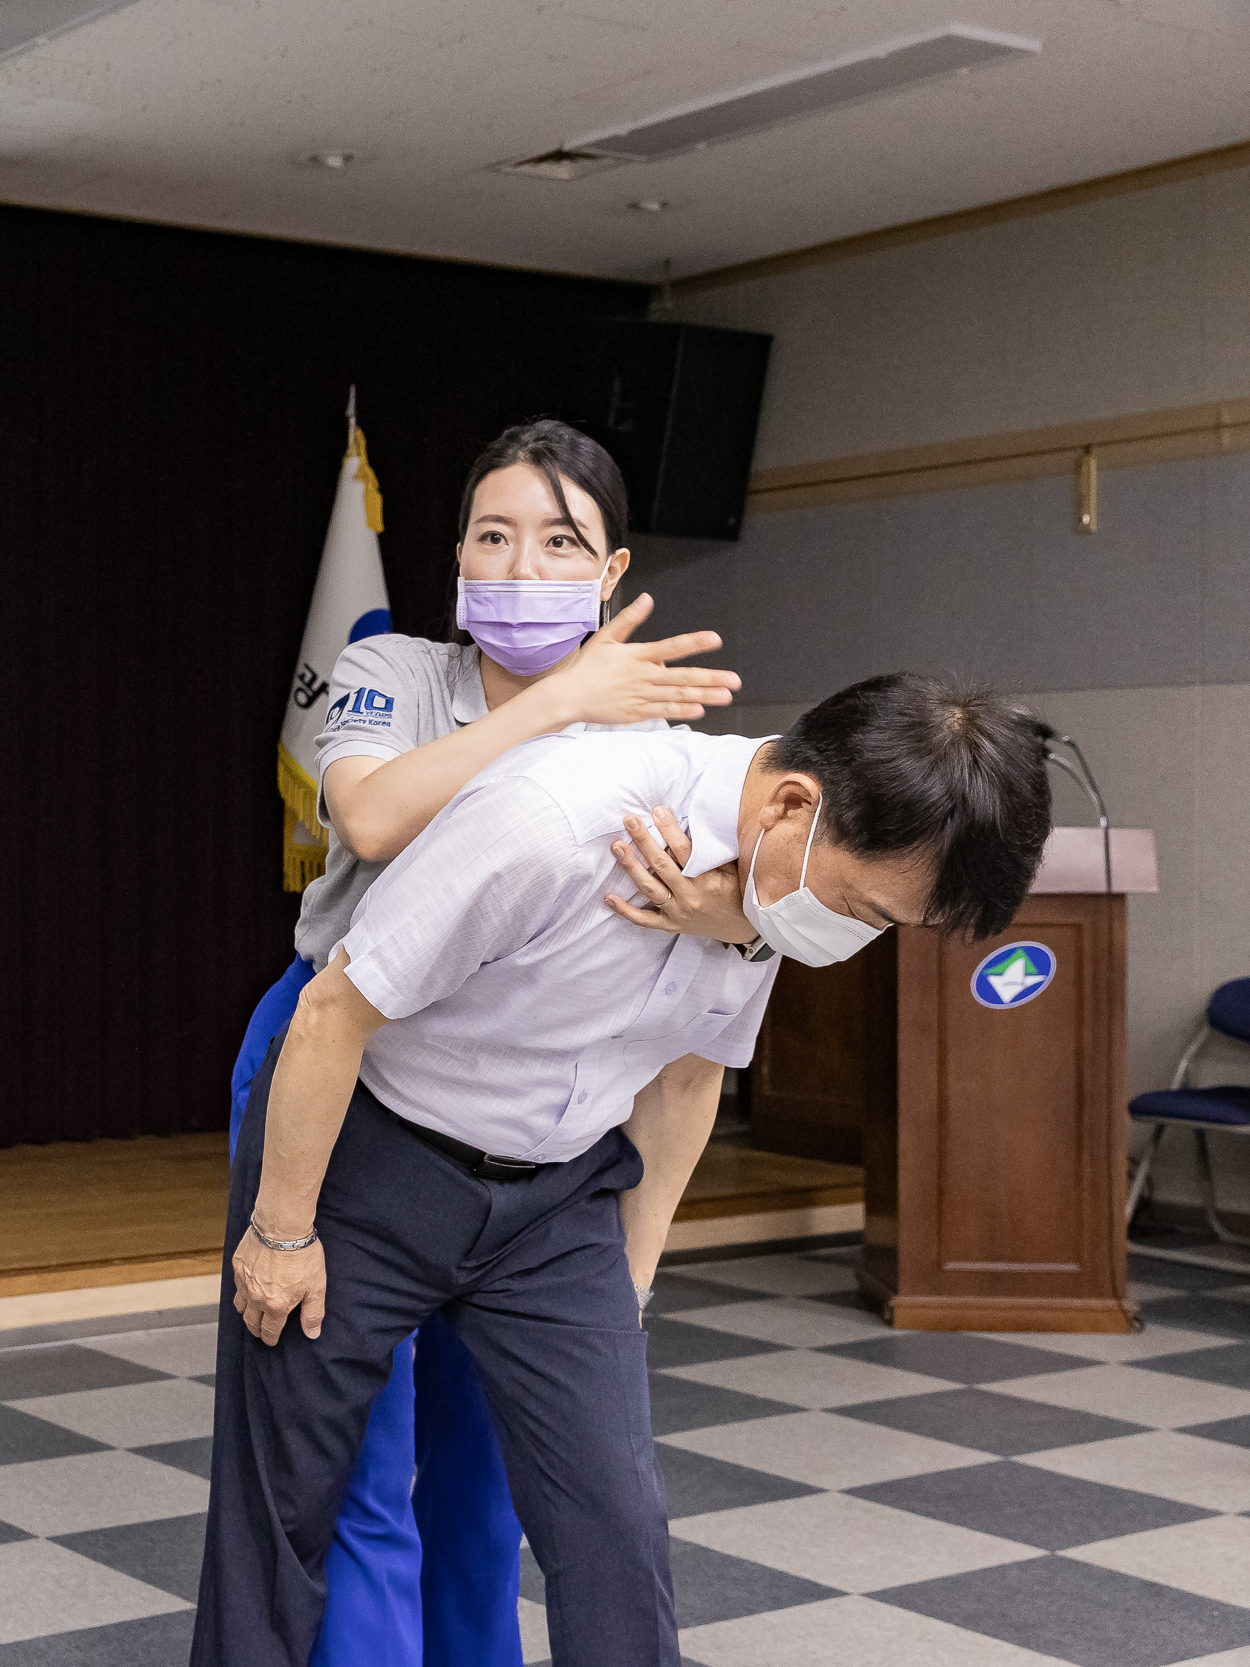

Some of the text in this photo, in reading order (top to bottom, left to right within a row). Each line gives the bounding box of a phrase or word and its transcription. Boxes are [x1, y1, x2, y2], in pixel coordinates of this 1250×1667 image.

[347, 687, 395, 714] 10
[340, 717, 391, 727] Society Korea
